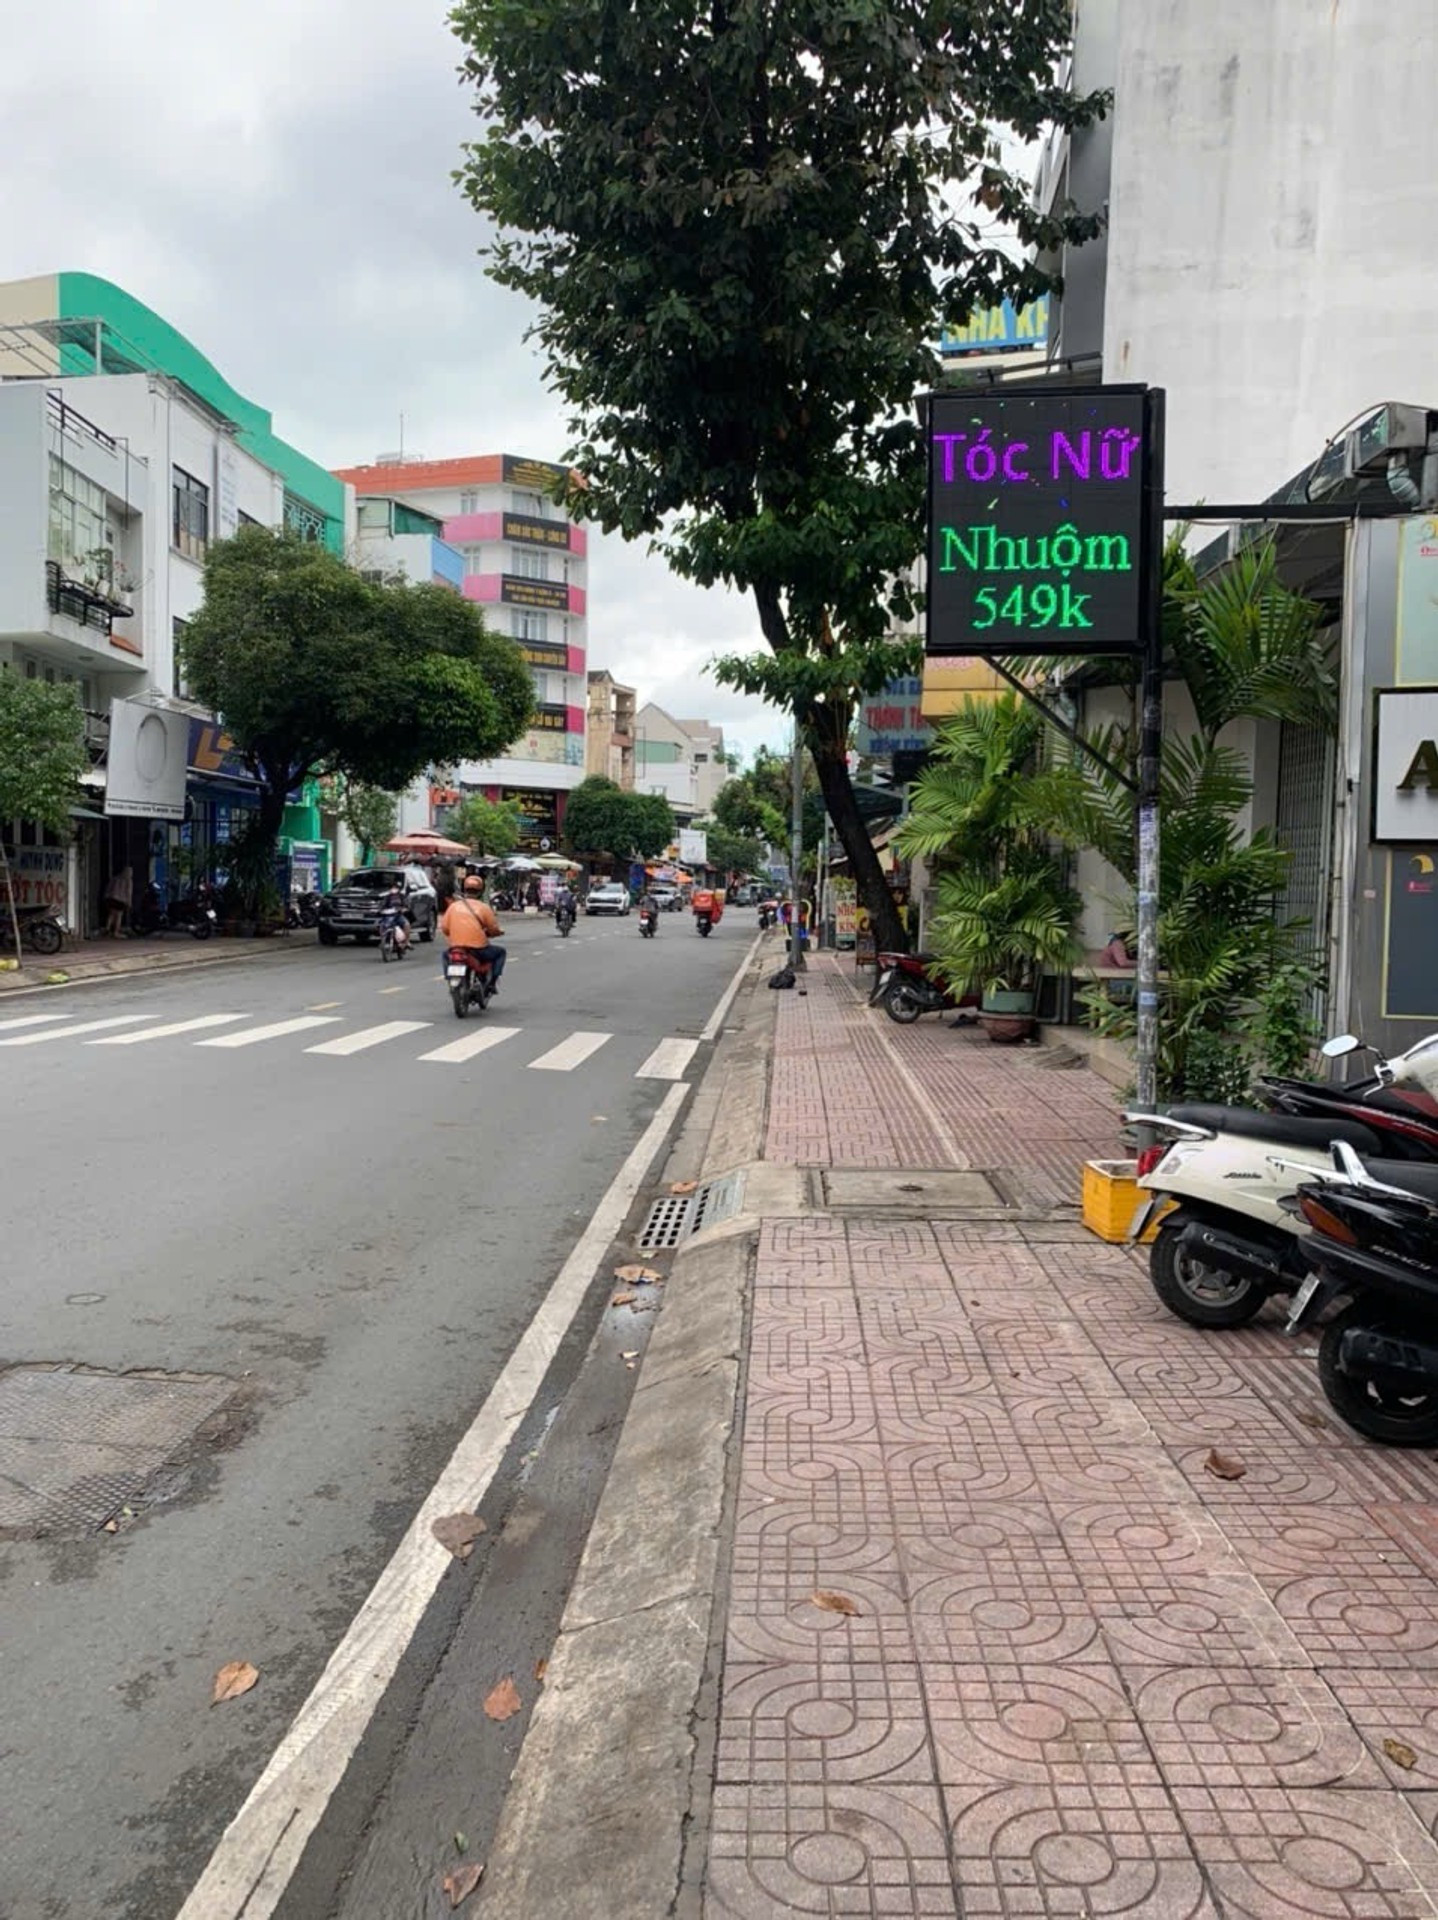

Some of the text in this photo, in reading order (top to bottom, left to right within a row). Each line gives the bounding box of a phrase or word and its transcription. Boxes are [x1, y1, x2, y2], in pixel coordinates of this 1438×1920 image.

[932, 428, 1141, 483] Tóc Nữ
[939, 523, 1132, 577] Nhuộm
[972, 583, 1093, 628] 549k
